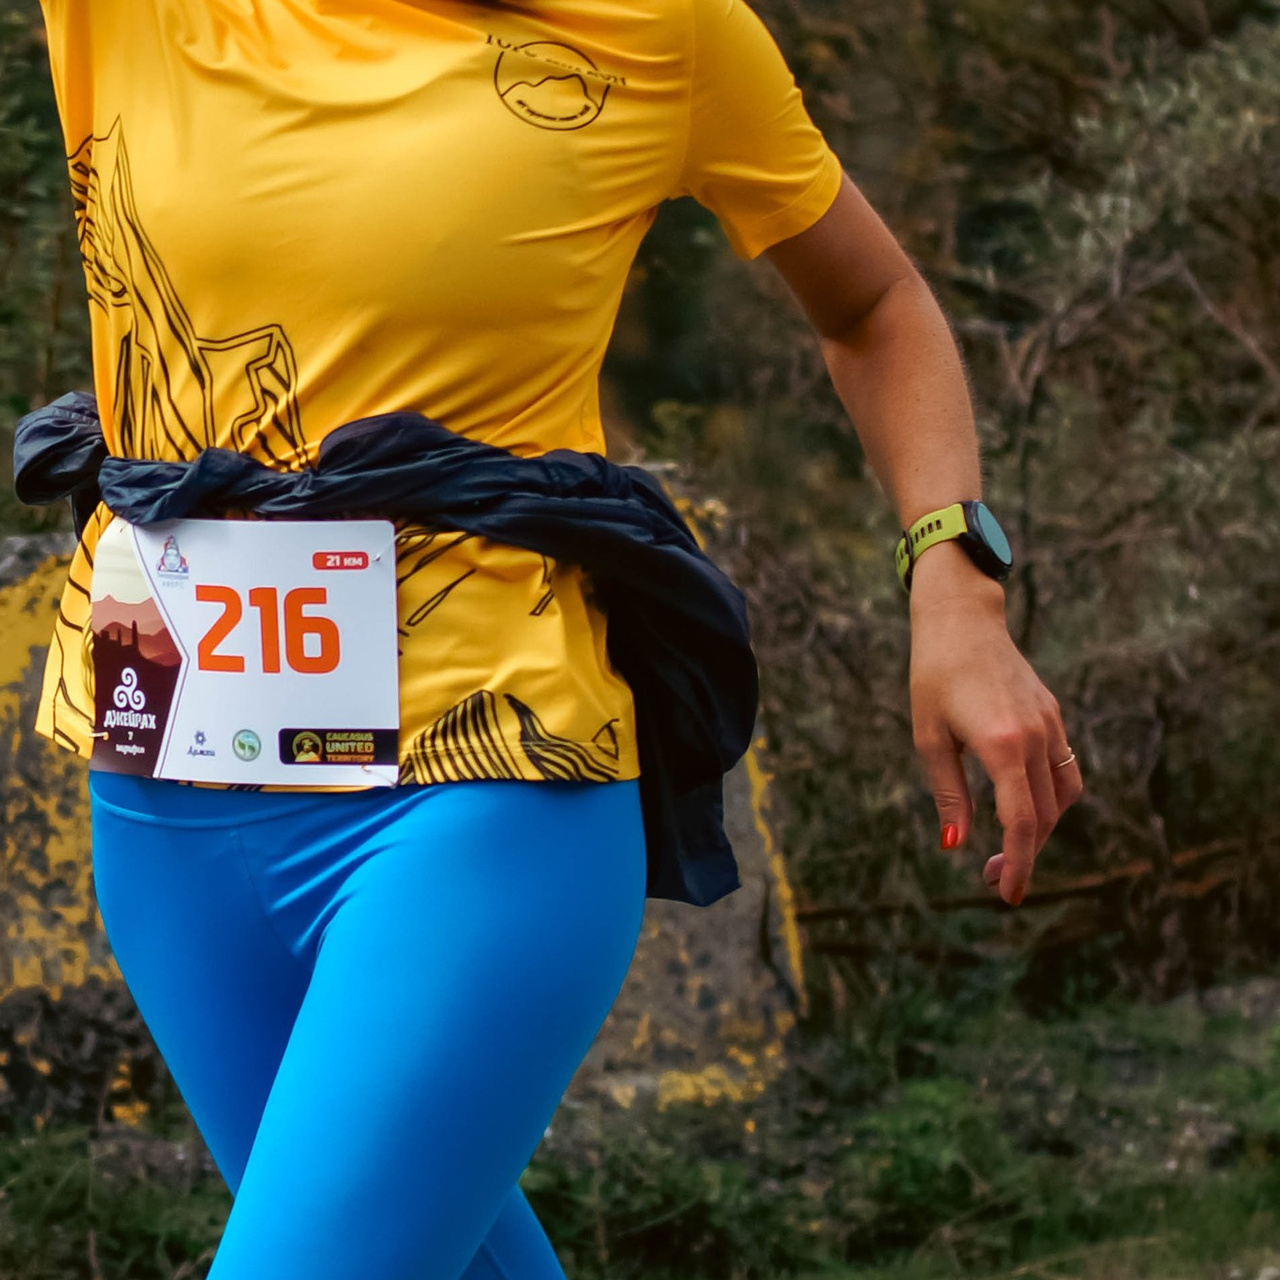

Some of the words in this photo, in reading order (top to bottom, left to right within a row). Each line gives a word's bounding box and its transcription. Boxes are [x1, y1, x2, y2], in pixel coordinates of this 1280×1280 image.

[326, 555, 341, 567] 21
[195, 584, 341, 674] 216
[104, 710, 157, 730] ДЖЕЙРАХ
[325, 742, 375, 753] UNITED
